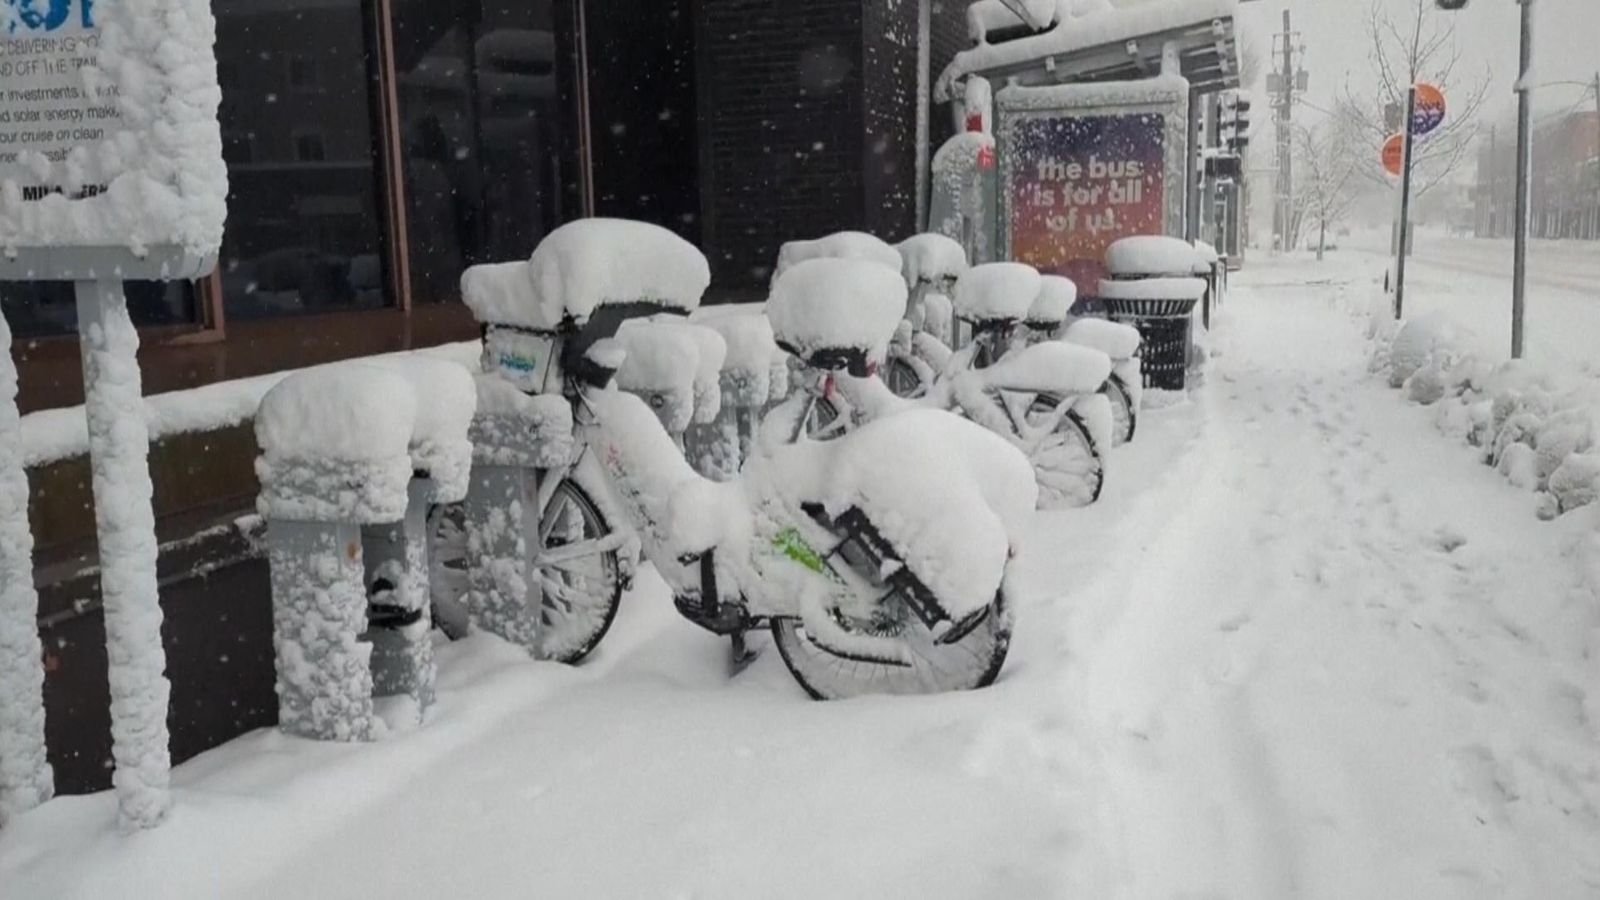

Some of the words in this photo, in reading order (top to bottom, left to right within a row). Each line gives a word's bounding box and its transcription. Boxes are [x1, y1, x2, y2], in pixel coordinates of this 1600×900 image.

[15, 60, 39, 76] OFF
[8, 86, 79, 101] investments
[14, 107, 40, 122] solar
[45, 108, 83, 122] energy
[21, 130, 53, 143] cruise
[56, 129, 70, 141] on
[73, 127, 104, 140] clean
[1038, 154, 1082, 180] the
[1089, 154, 1139, 179] bus
[1033, 182, 1054, 206] is
[1063, 182, 1102, 206] for
[1108, 179, 1142, 204] all
[1050, 206, 1078, 231] of
